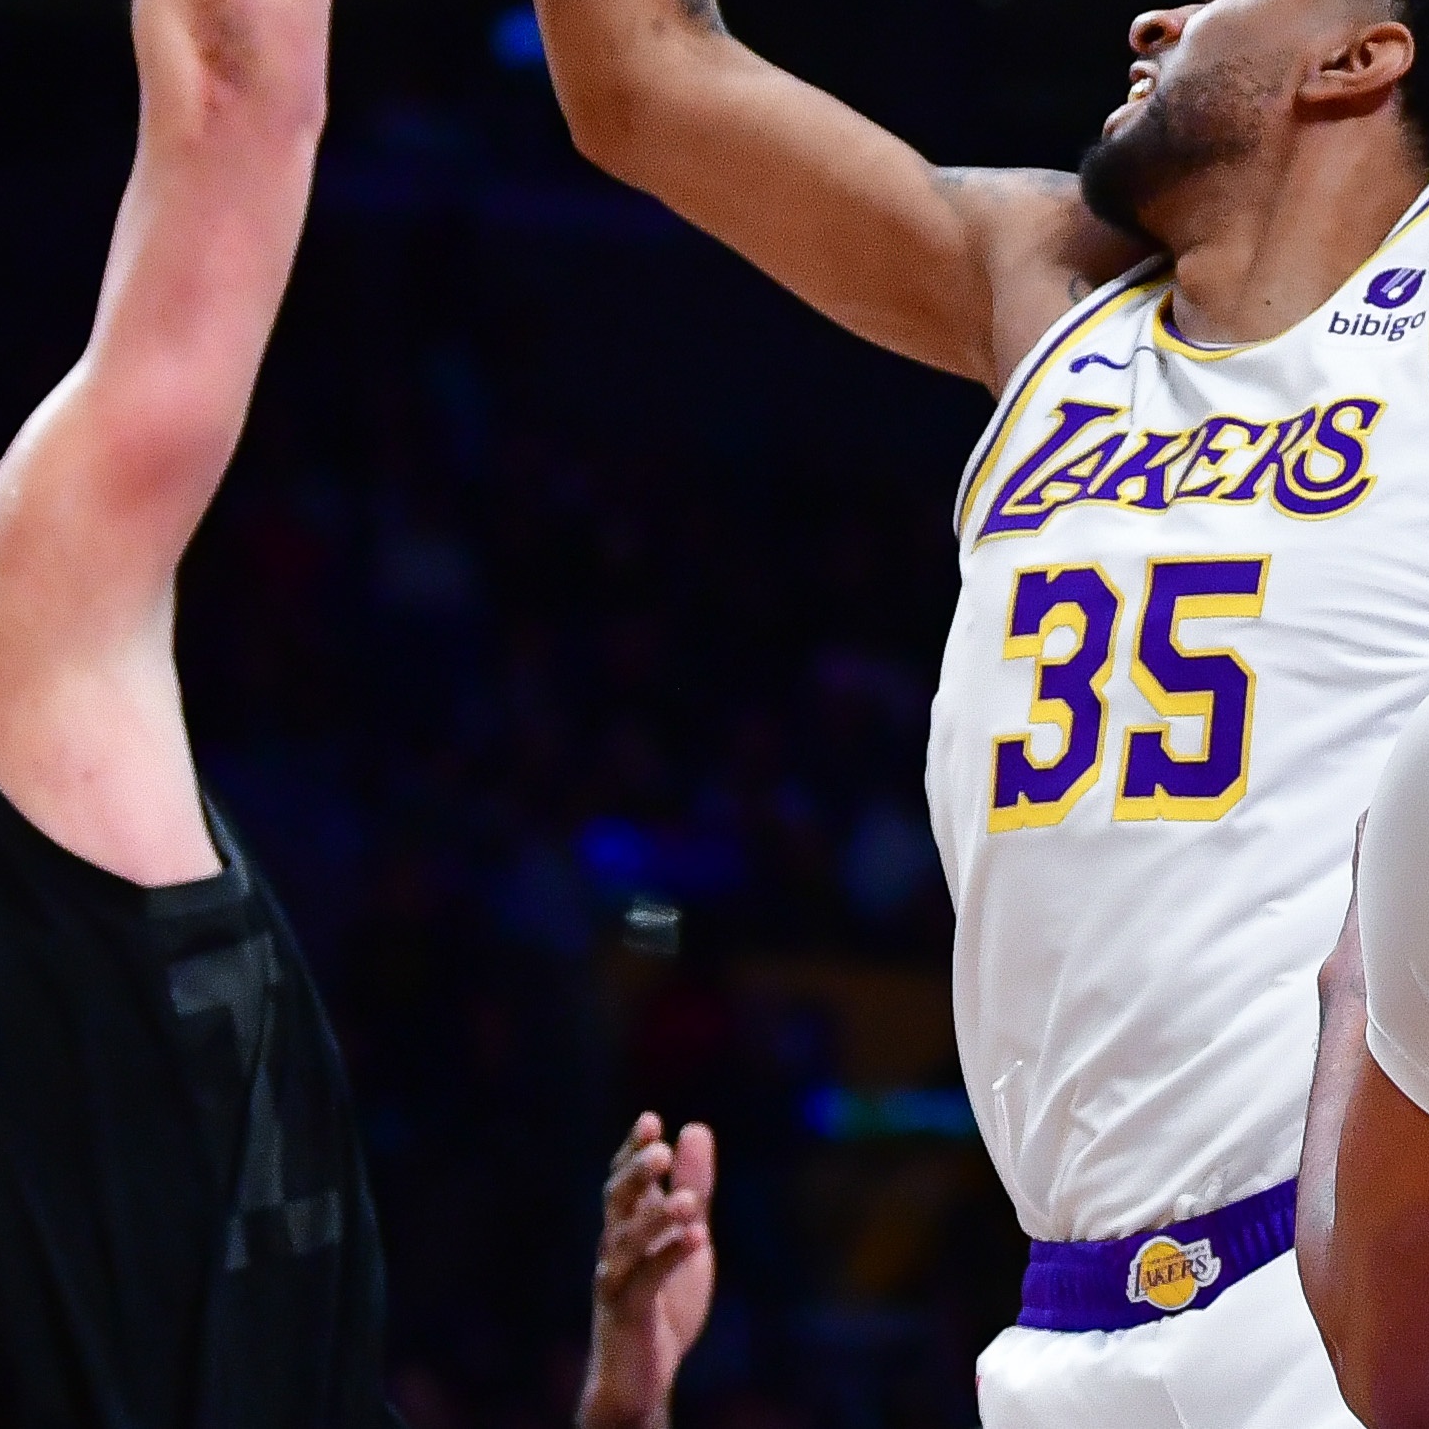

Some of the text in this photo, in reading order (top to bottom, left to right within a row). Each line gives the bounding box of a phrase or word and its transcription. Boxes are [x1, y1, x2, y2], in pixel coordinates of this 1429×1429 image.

[1328, 311, 1426, 342] bibigo
[973, 398, 1388, 548] LAKERS
[987, 554, 1272, 834] 35
[1132, 1252, 1212, 1299] LAKERS
